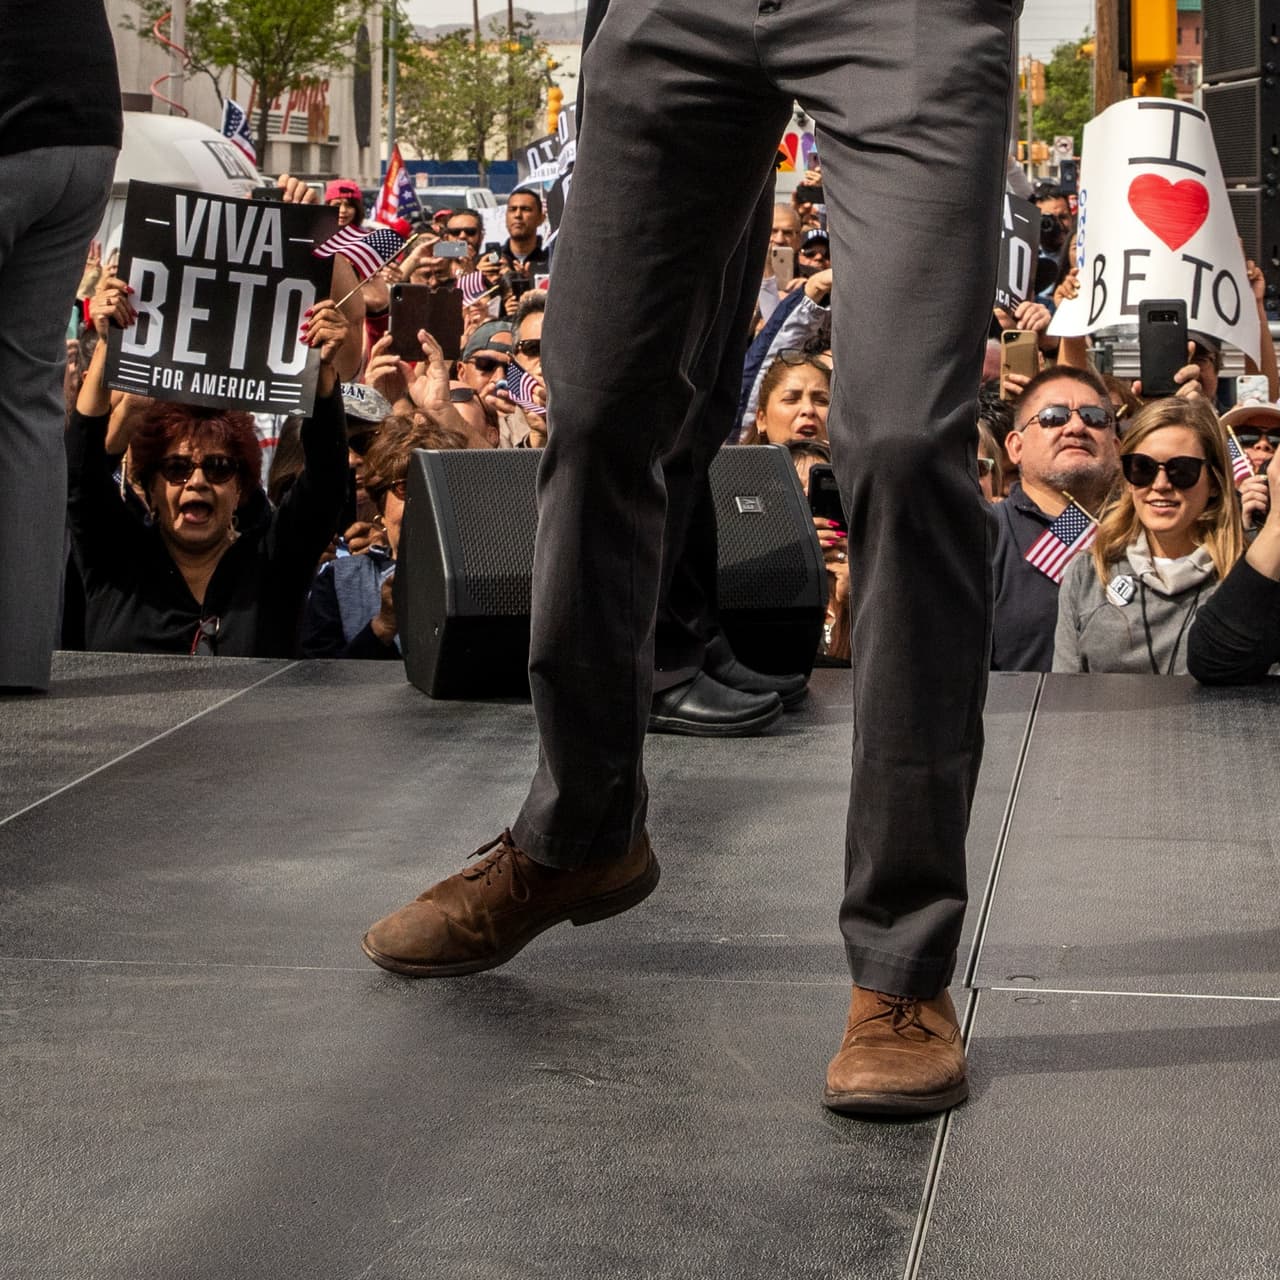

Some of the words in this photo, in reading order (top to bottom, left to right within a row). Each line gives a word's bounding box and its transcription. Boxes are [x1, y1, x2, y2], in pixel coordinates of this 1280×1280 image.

[1128, 101, 1207, 178] I
[175, 194, 285, 269] VIVA
[121, 257, 317, 377] BETO
[1087, 248, 1242, 327] BETO
[151, 367, 184, 392] FOR
[190, 372, 266, 403] AMERICA
